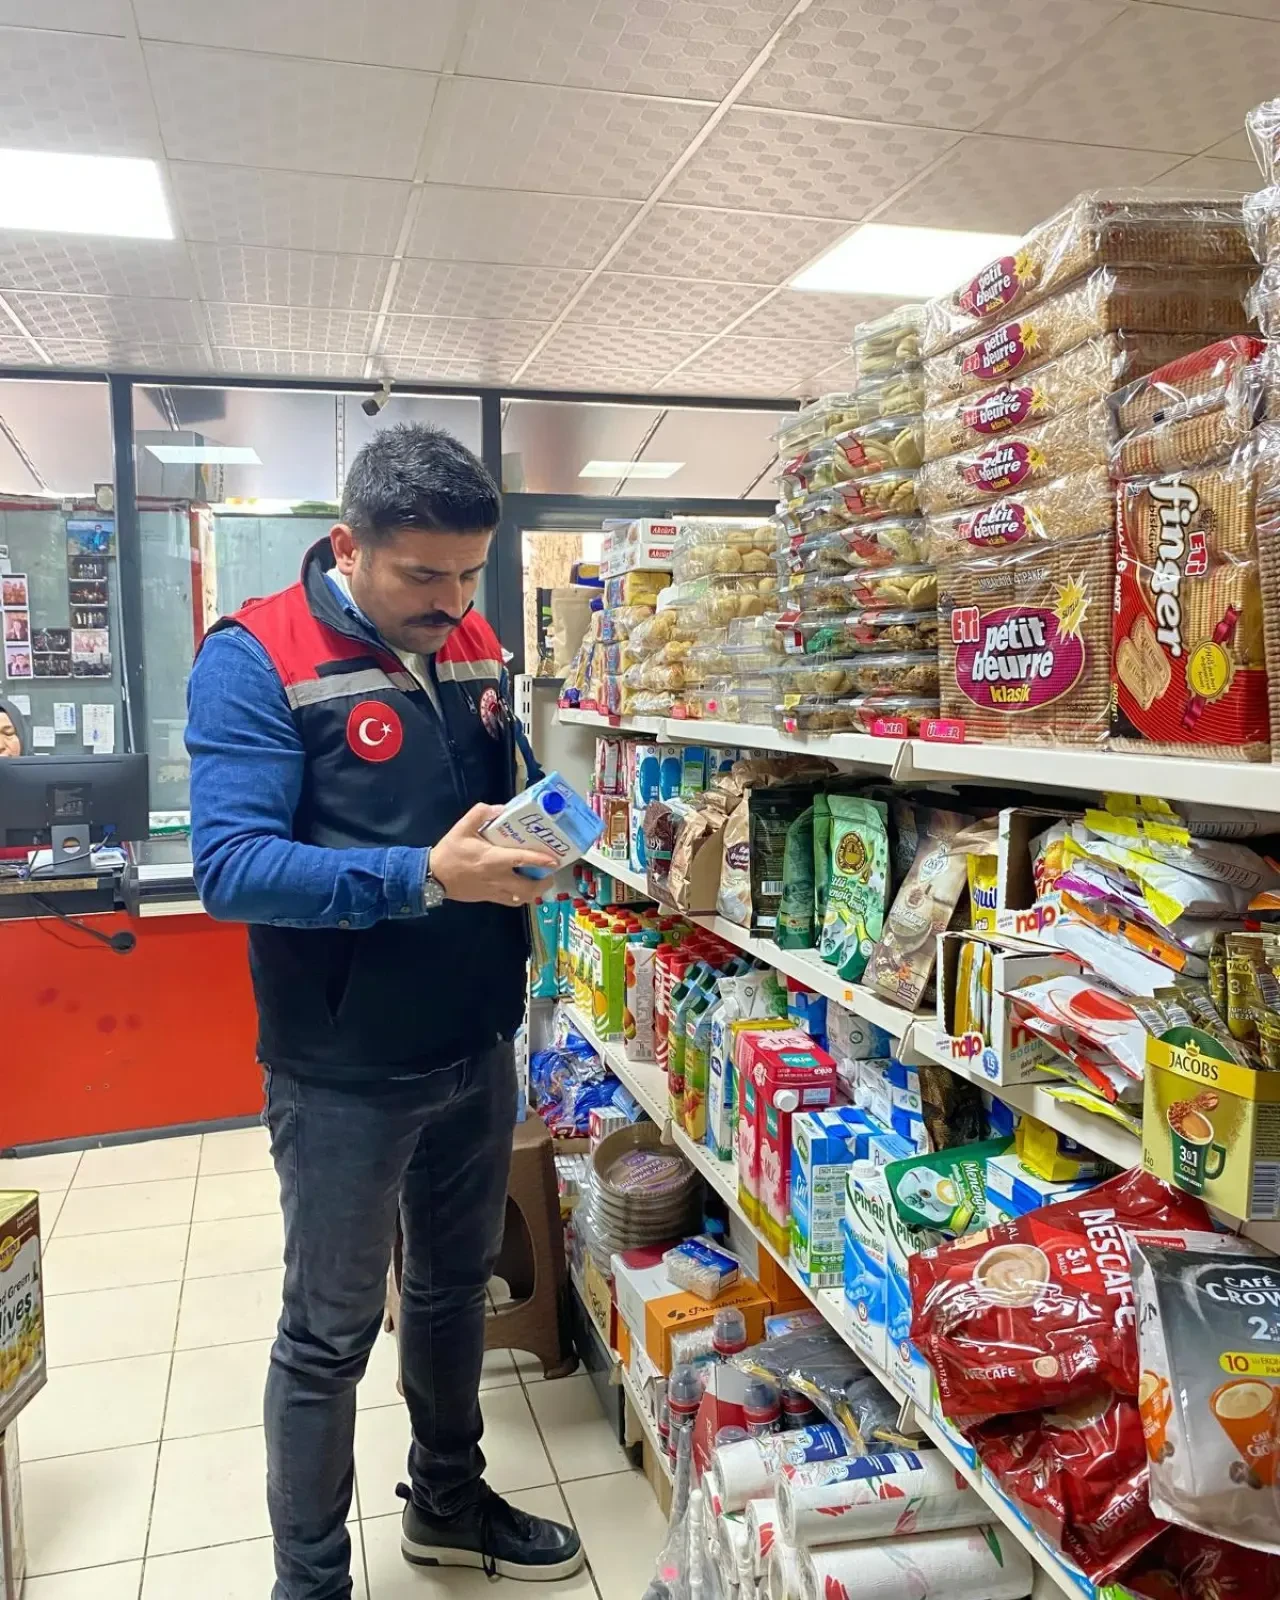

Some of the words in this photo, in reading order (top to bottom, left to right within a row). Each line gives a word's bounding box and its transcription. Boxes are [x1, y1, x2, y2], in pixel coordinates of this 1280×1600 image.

[977, 275, 1011, 307] beurre
[982, 341, 1016, 368] beurre
[984, 328, 1008, 354] petit
[980, 402, 1021, 424] beurre
[979, 460, 1021, 482] beurre
[974, 521, 1019, 539] beurre
[1148, 480, 1200, 658] finger
[1114, 575, 1122, 612] PAKET
[984, 617, 1045, 660] petit
[972, 651, 1054, 680] beurre
[990, 684, 1031, 702] klasik
[1169, 1051, 1219, 1081] JACOBS
[8, 1272, 30, 1299] Green
[1224, 1275, 1277, 1289] CAFÉ
[1225, 1354, 1249, 1372] 10
